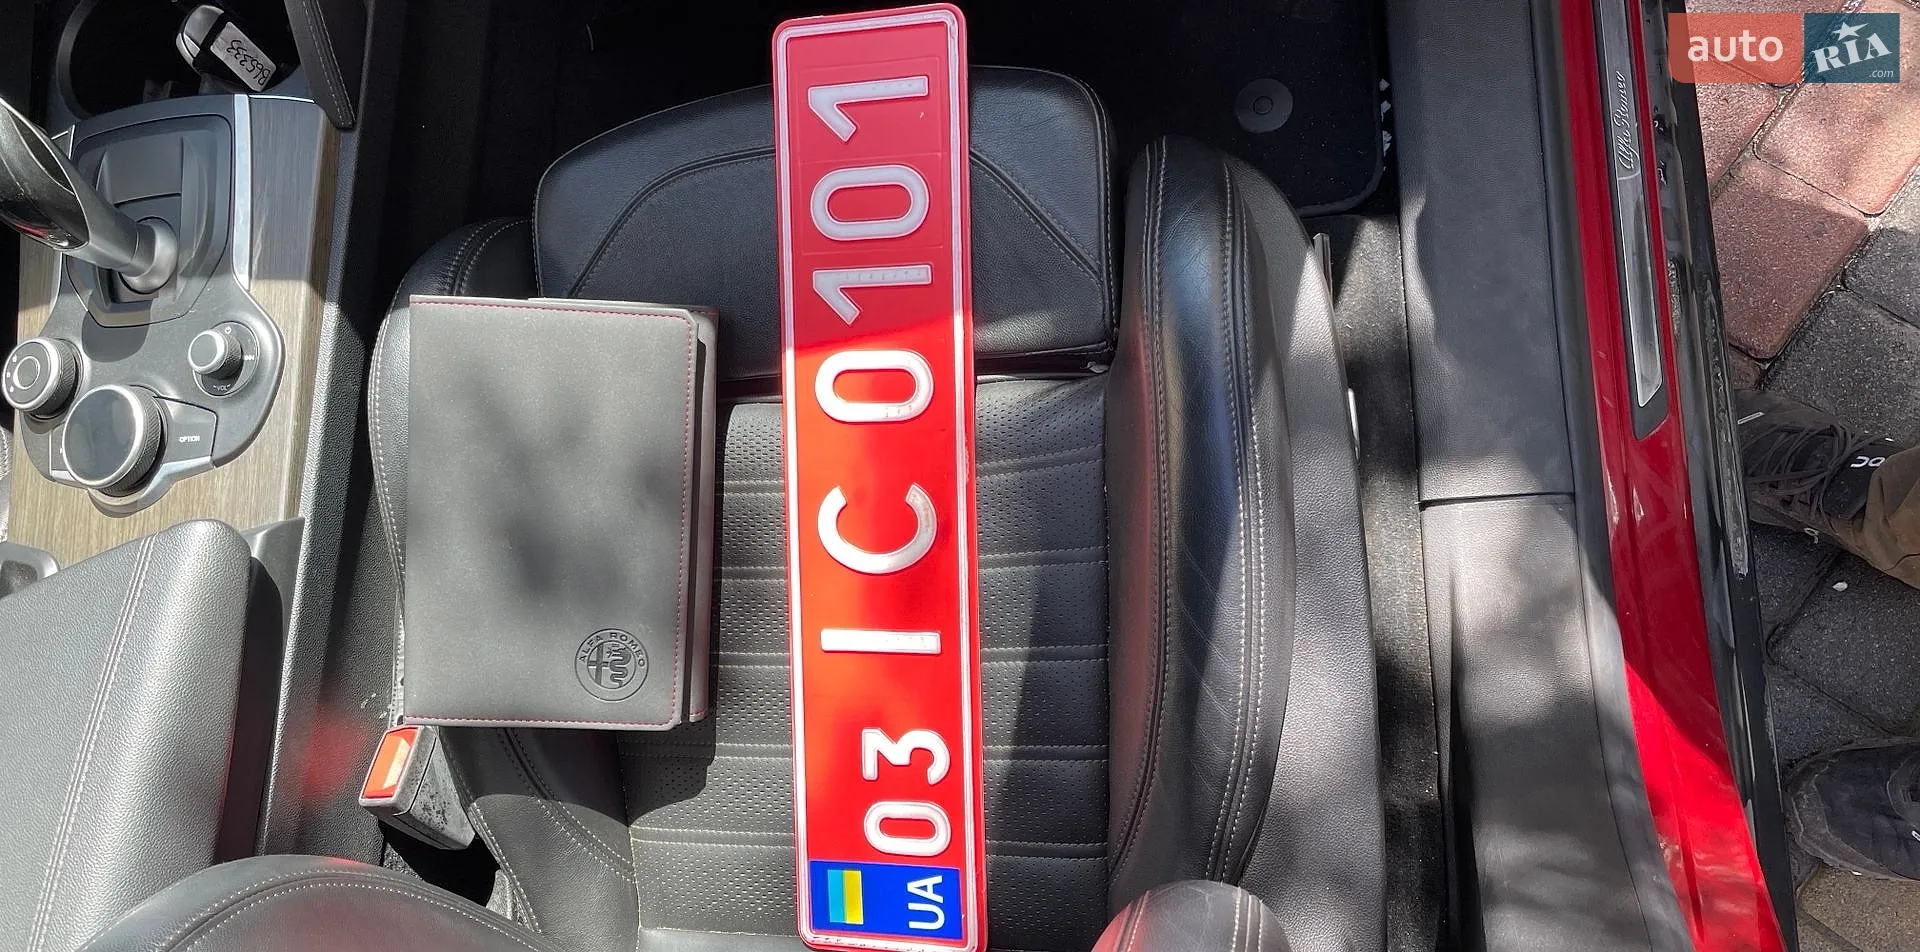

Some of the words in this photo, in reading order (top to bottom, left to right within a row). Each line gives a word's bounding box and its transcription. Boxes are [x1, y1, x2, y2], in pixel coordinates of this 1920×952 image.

[1613, 70, 1631, 128] Romeo
[1615, 129, 1641, 170] Alfa
[808, 75, 934, 423] 0101
[179, 435, 200, 443] OPTION
[578, 634, 605, 663] ALFA
[608, 631, 646, 668] ROMEO
[861, 727, 951, 857] 03
[906, 875, 945, 931] UA
